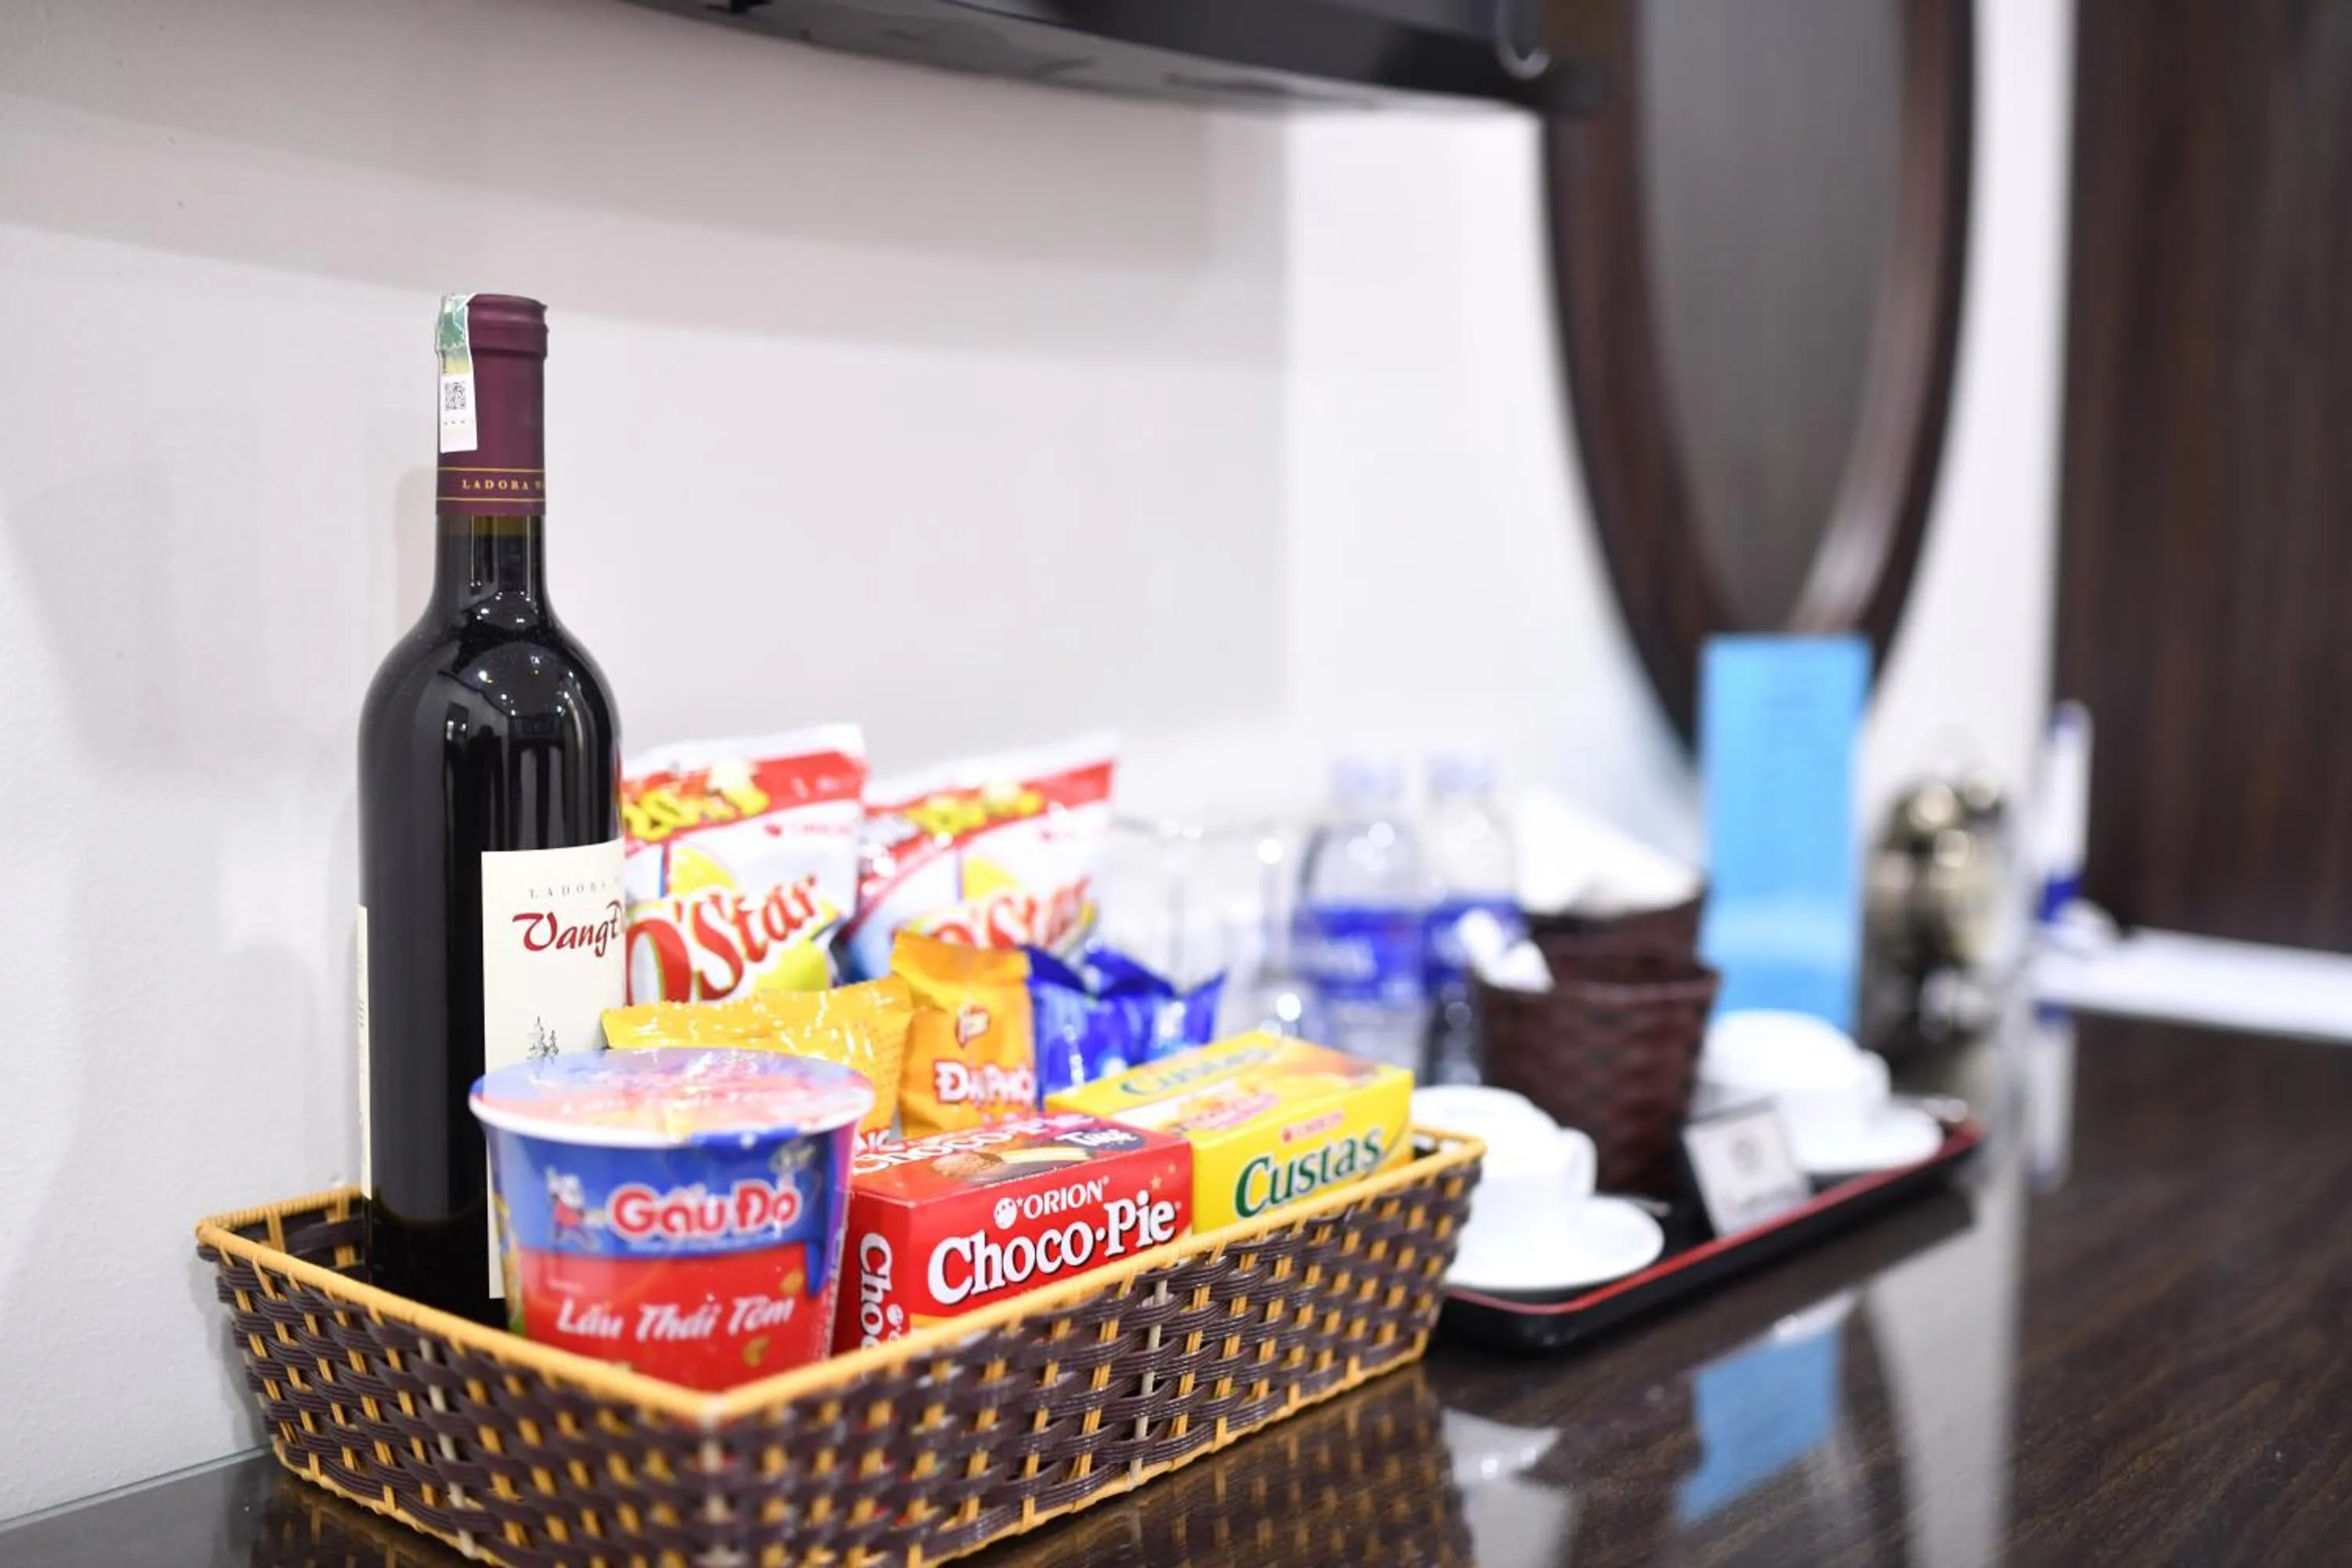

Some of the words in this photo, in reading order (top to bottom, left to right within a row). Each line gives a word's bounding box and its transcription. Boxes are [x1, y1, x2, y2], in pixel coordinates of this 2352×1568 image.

[462, 478, 528, 490] LADORA
[1234, 1127, 1383, 1218] Custas
[1023, 1182, 1103, 1220] ORION
